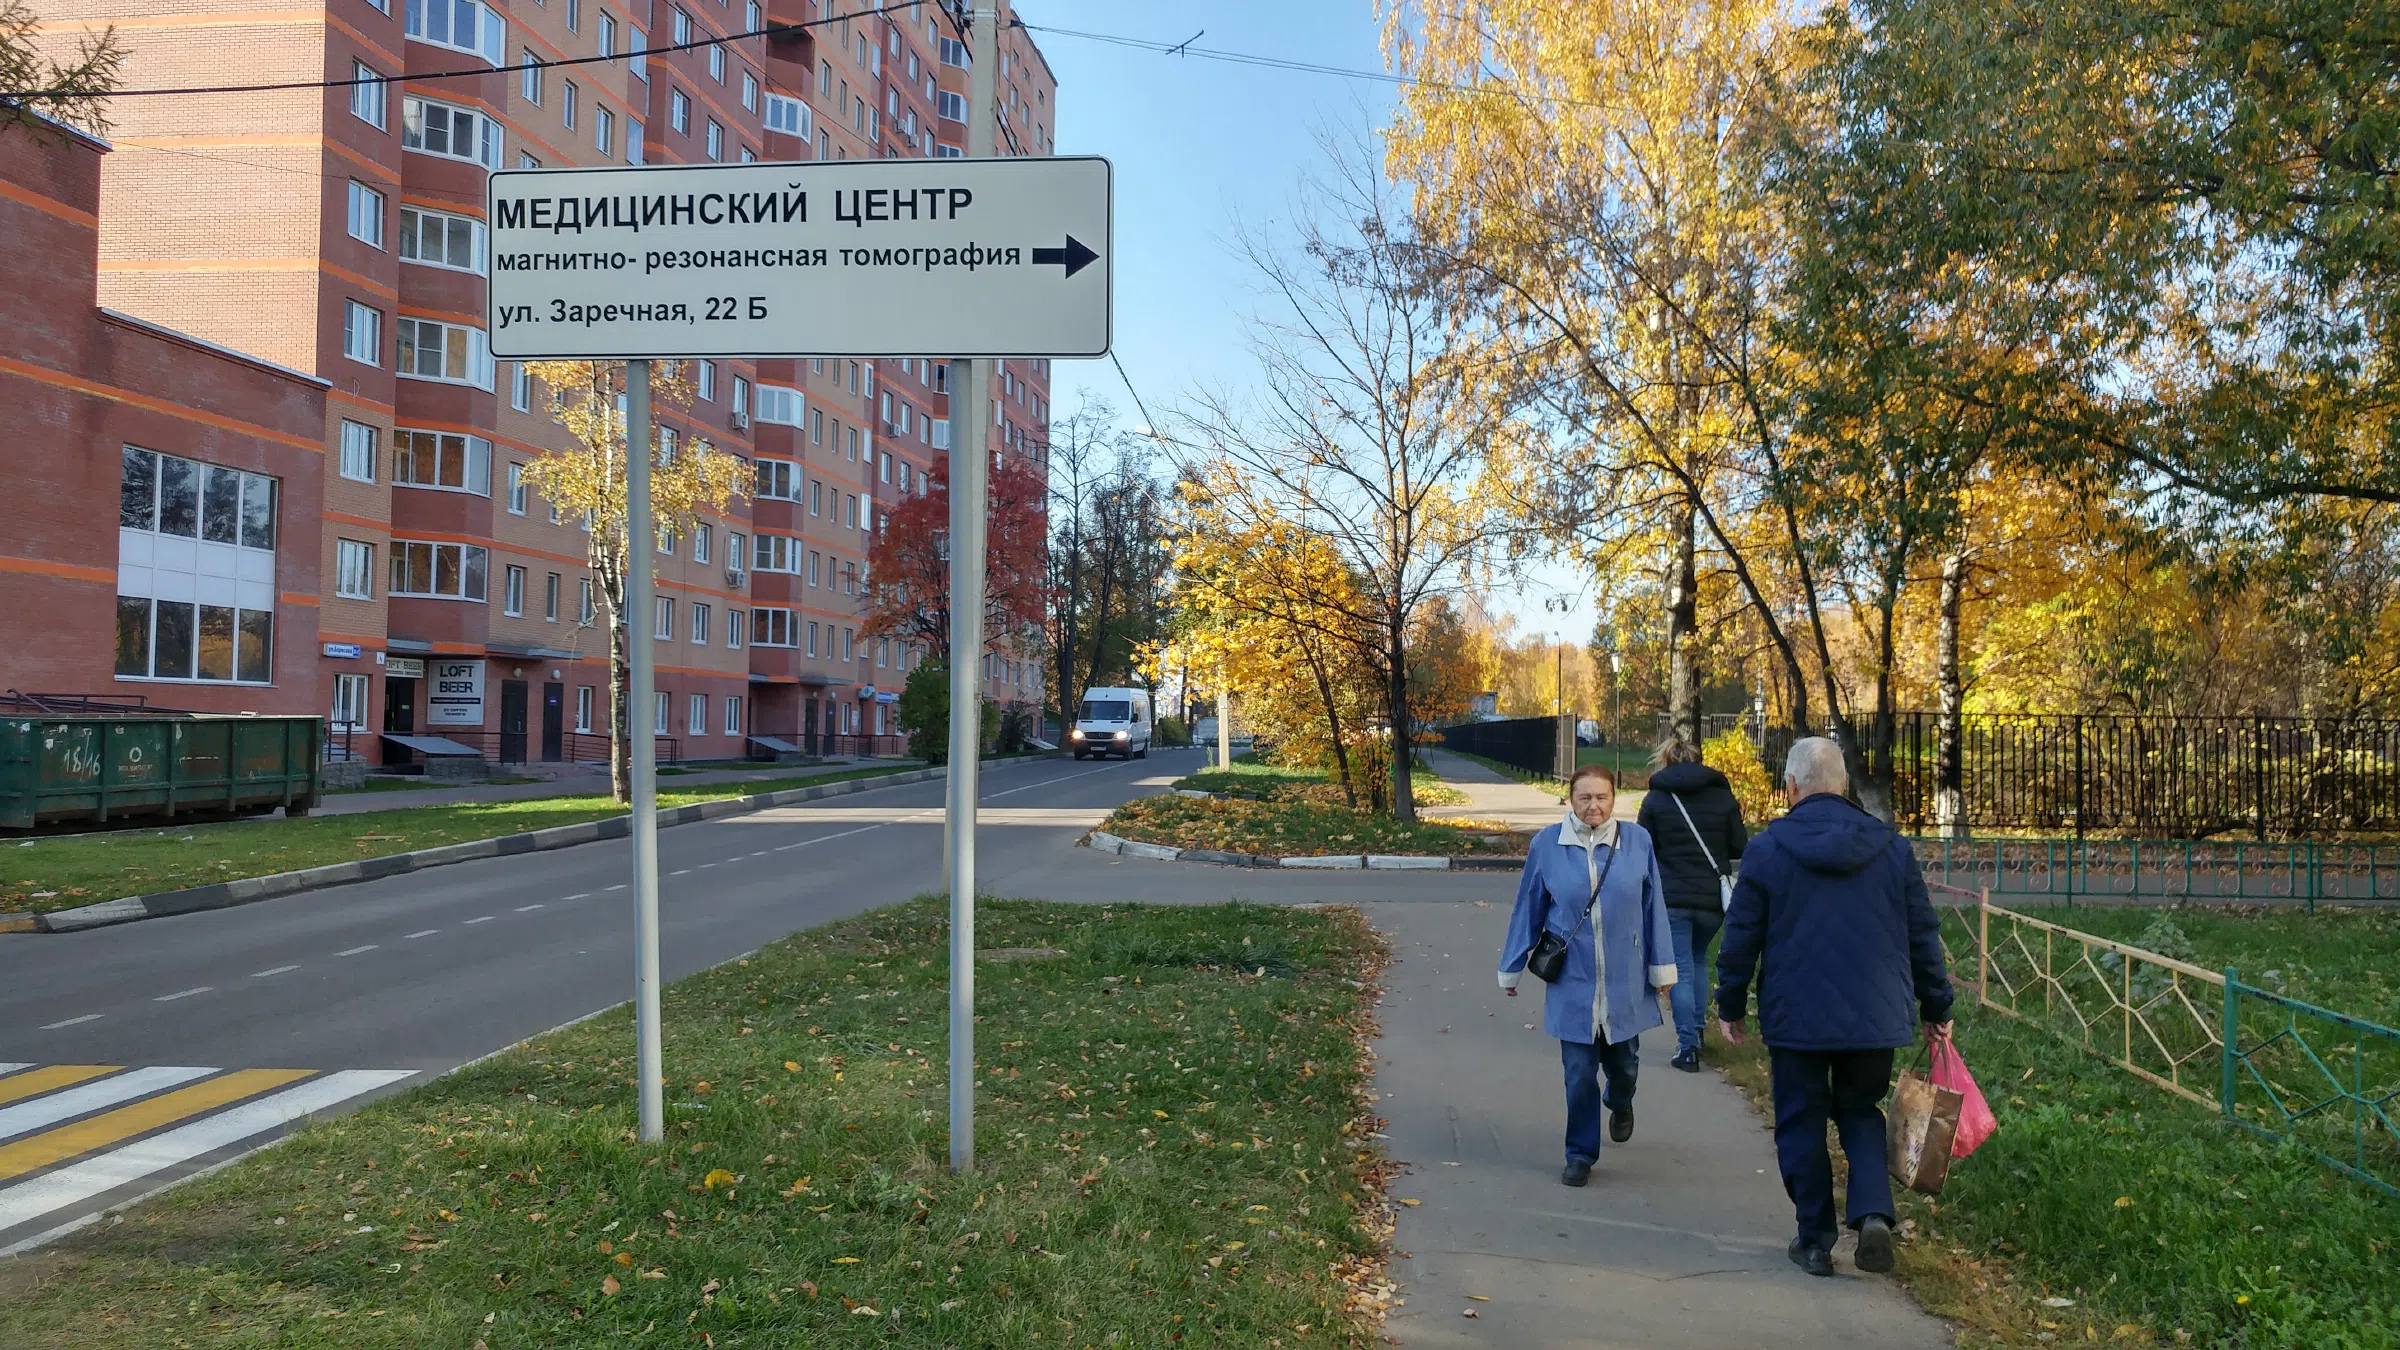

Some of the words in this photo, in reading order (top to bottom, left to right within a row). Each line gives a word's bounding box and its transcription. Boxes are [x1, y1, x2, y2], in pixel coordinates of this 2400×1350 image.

[497, 183, 807, 235] МЕДИЦИНСКИЙ
[835, 188, 973, 228] ЦЕНТР
[497, 252, 637, 271] магнитно-
[645, 249, 827, 275] резонансная
[839, 242, 1020, 272] томография
[498, 305, 540, 329] ул.
[550, 298, 695, 328] Заречная,
[705, 296, 737, 320] 22
[748, 296, 768, 320] Б
[403, 660, 423, 671] BEER
[439, 665, 475, 678] LOFT
[439, 681, 474, 693] BEER
